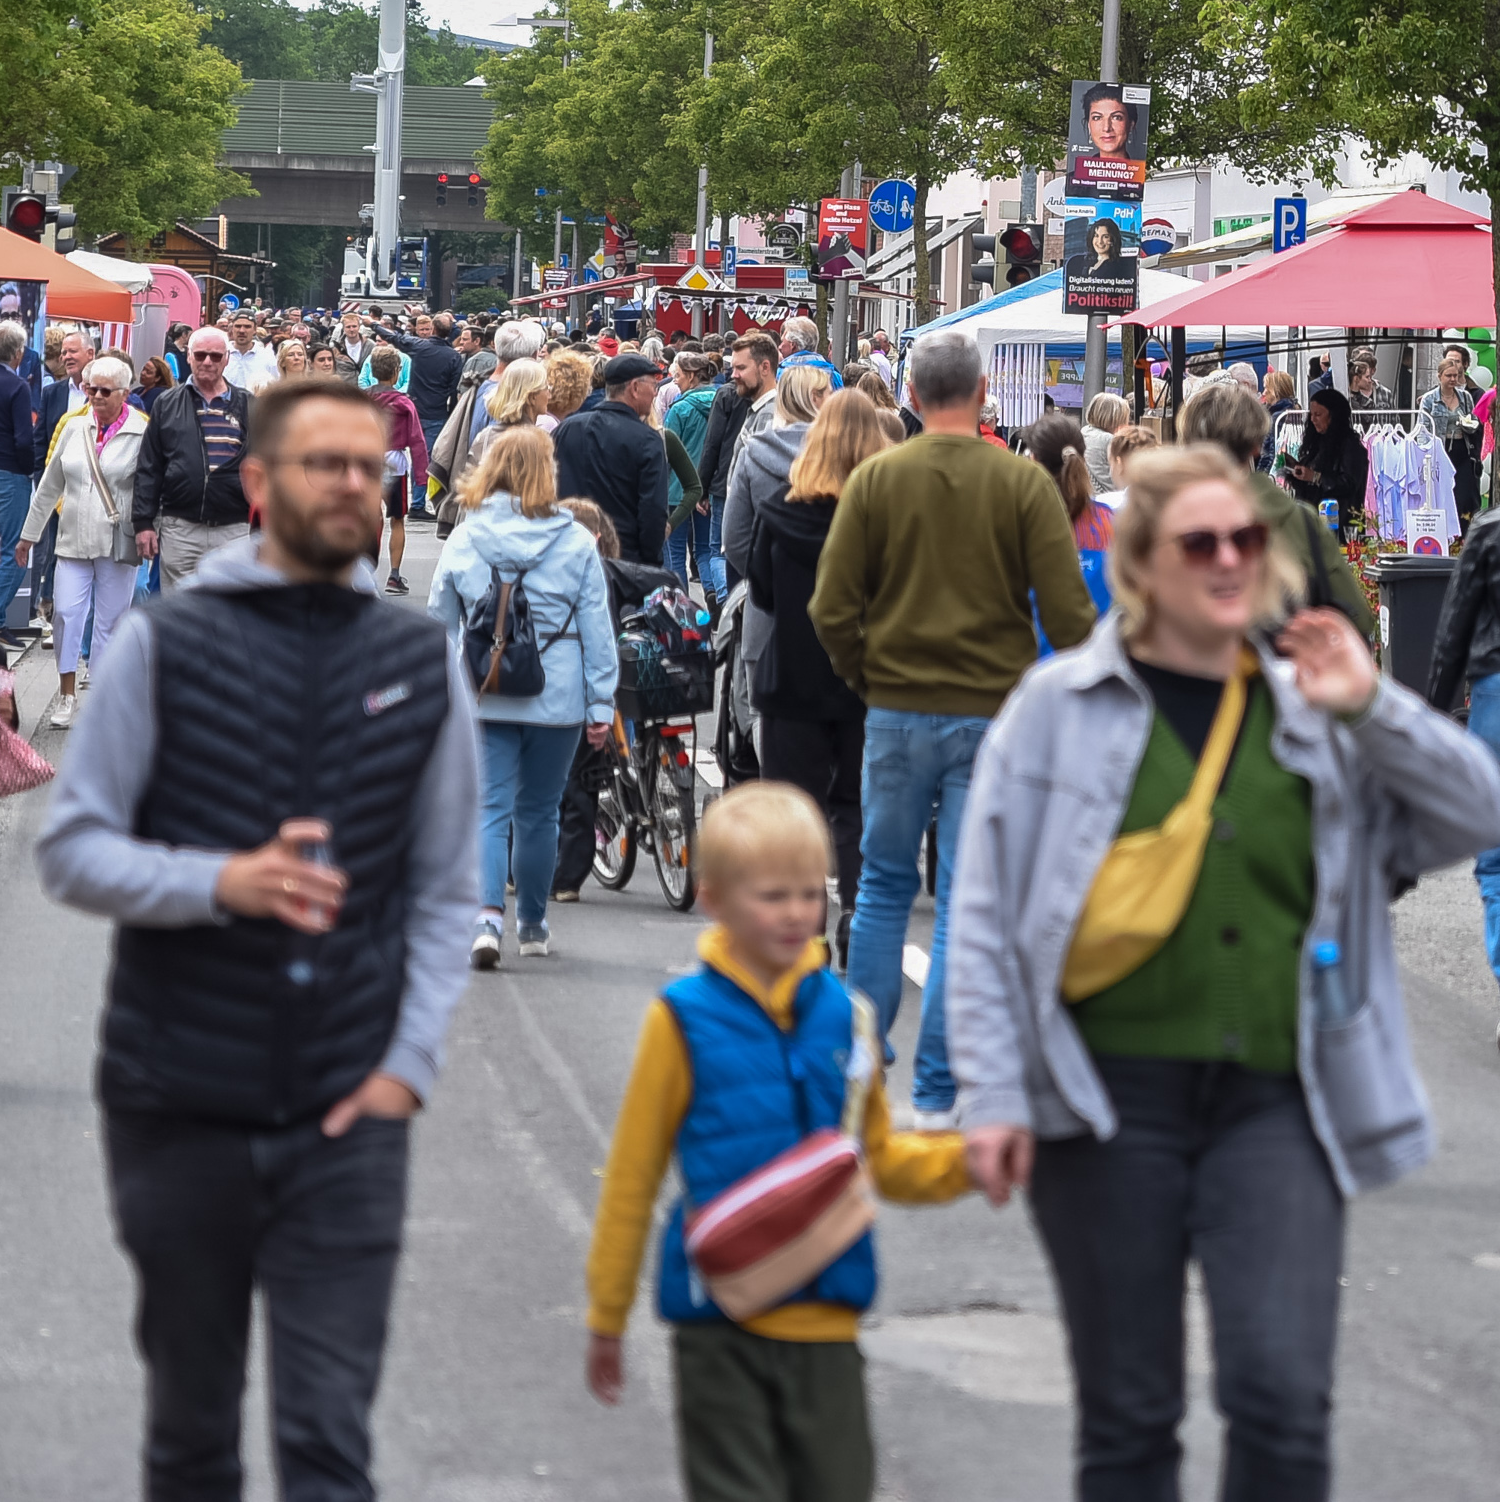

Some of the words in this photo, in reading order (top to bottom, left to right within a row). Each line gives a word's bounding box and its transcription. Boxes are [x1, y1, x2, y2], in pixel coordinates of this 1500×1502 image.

[1088, 169, 1135, 179] MEINUNG?
[1046, 196, 1065, 206] Ank
[1113, 207, 1135, 219] PdH
[1280, 204, 1300, 248] P
[1141, 229, 1172, 239] RE/MAX
[1068, 276, 1115, 285] Digitalisierung
[1067, 292, 1134, 308] Politikstil!
